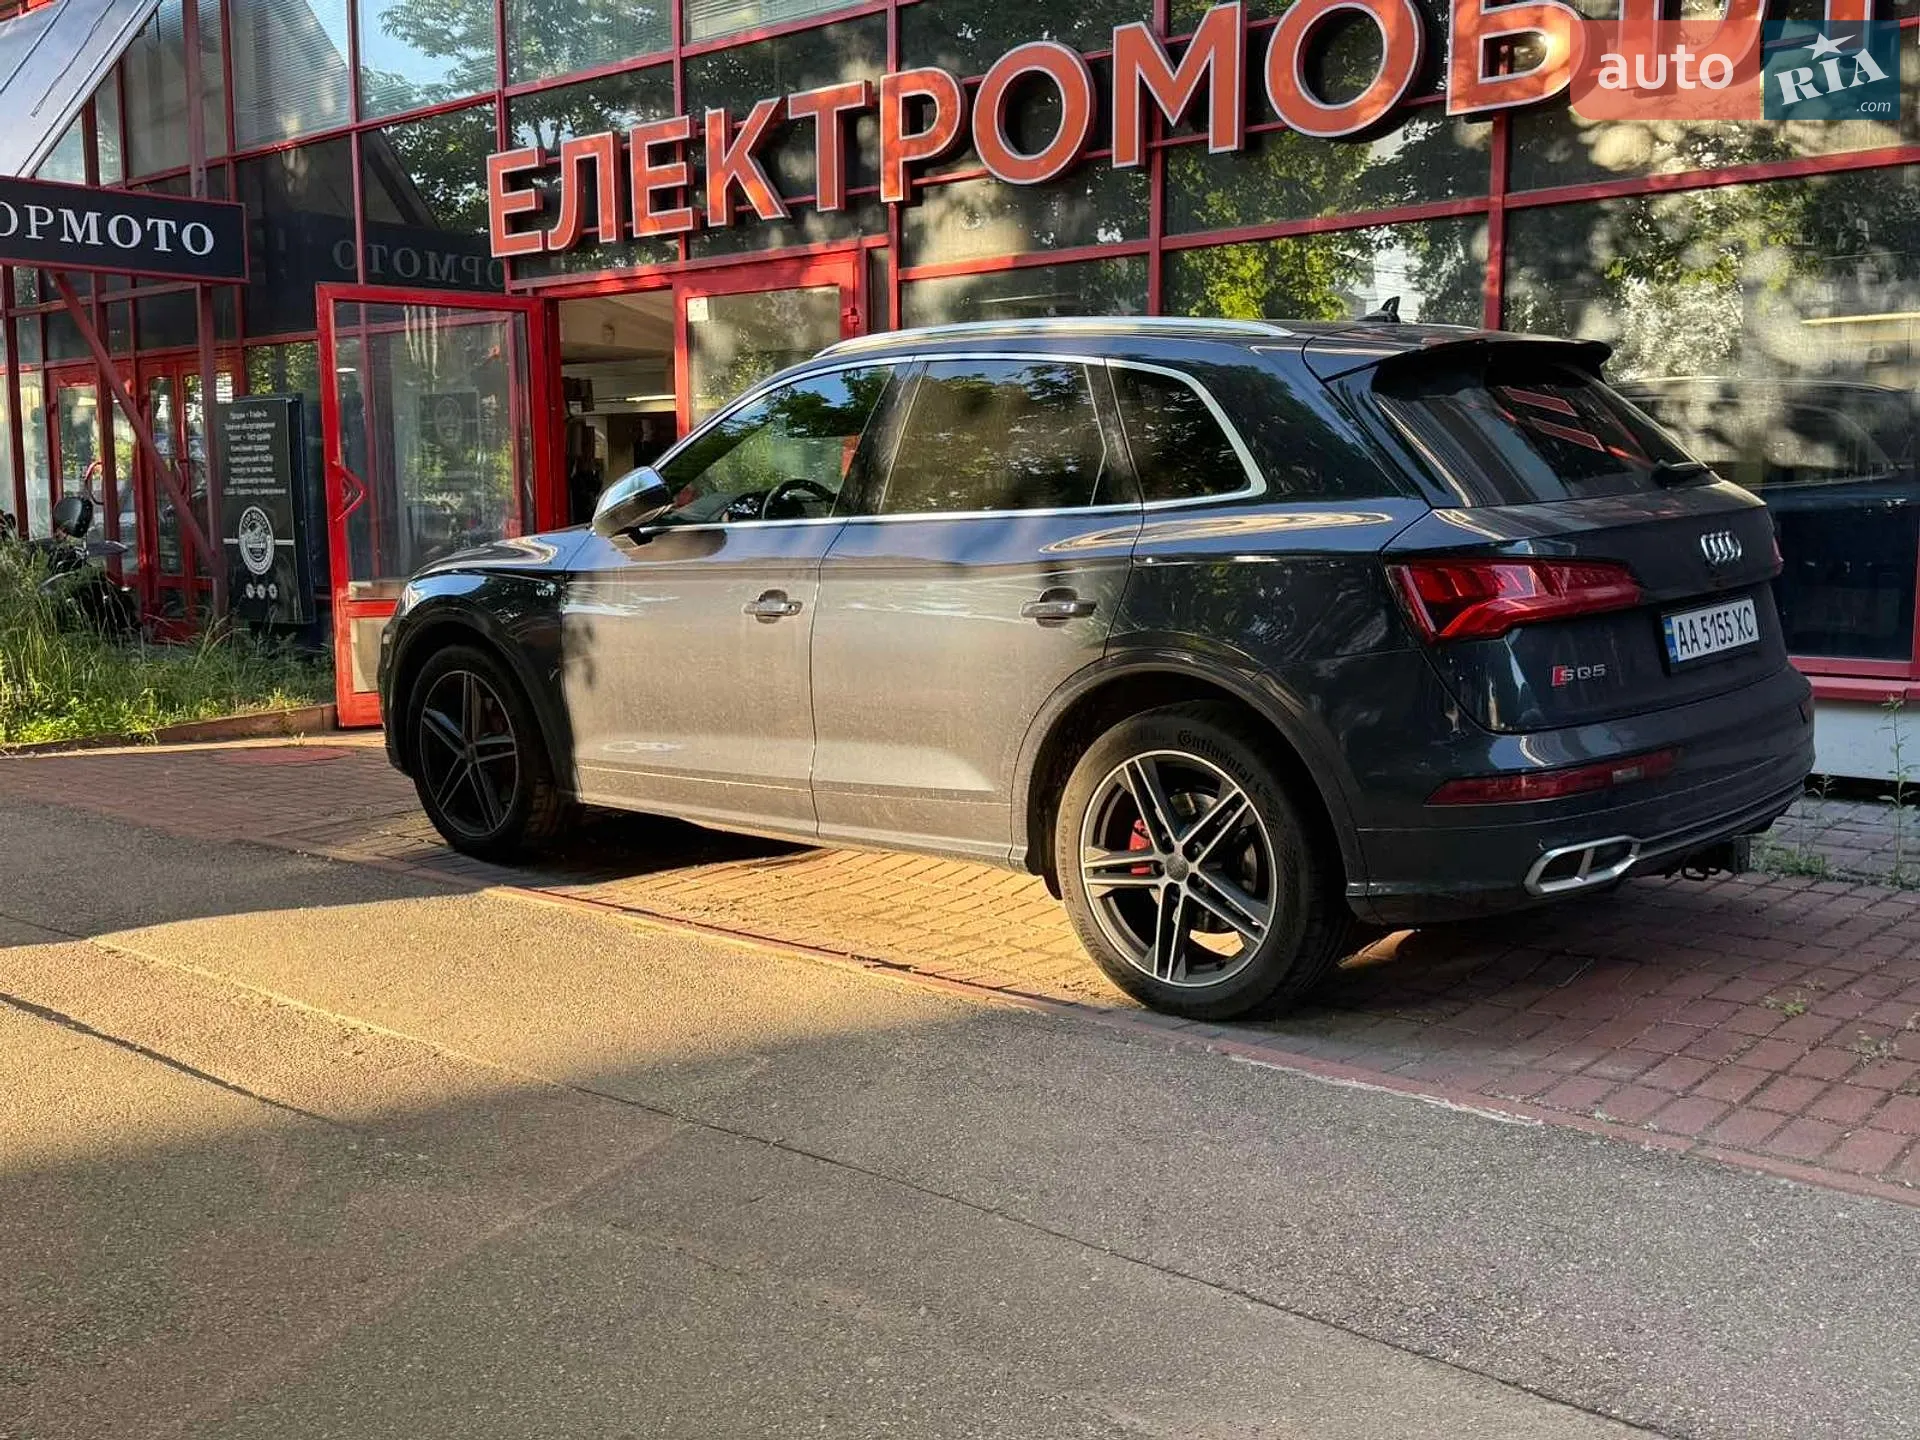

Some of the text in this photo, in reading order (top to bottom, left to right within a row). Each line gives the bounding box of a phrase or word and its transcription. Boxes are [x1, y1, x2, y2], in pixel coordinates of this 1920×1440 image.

[1678, 618, 1700, 655] AA
[1701, 611, 1734, 650] 5155
[1732, 606, 1754, 641] XC
[1557, 664, 1606, 683] SQ5
